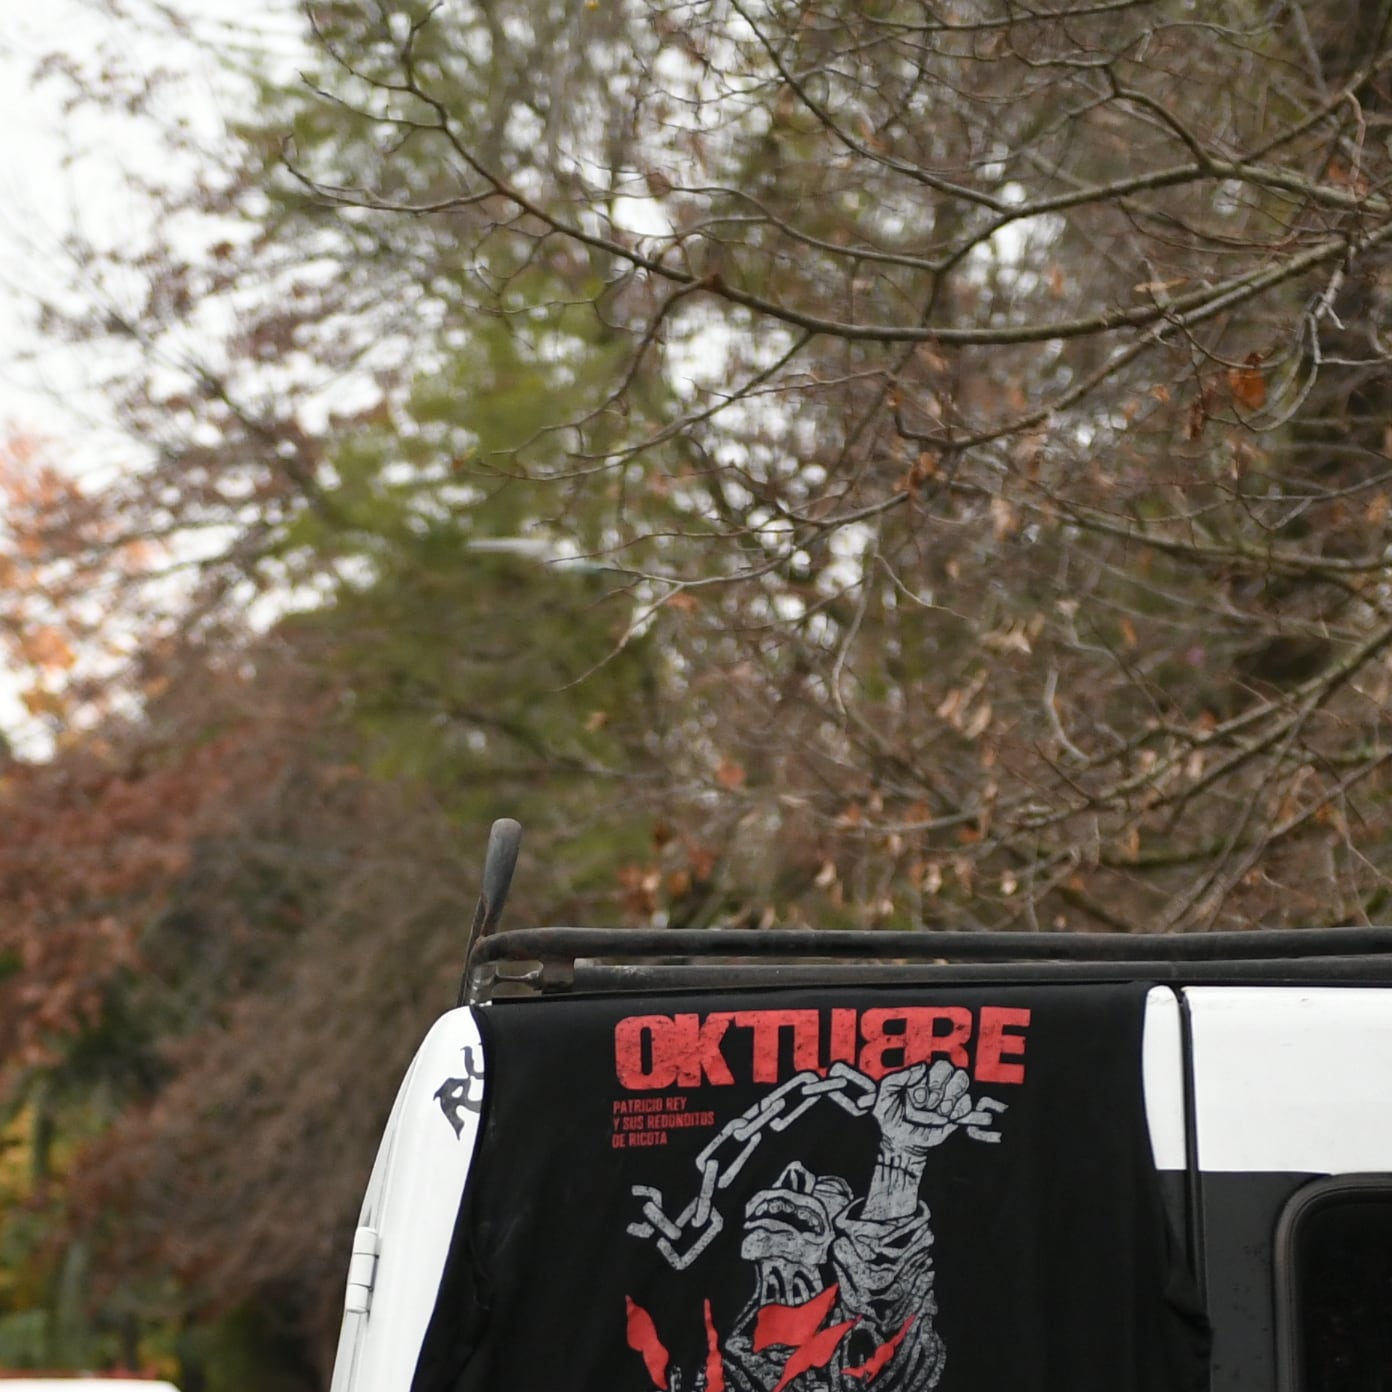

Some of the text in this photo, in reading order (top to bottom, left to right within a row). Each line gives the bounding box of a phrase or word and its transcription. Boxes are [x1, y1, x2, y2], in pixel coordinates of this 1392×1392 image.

[614, 1005, 1031, 1092] OKTUBRE
[613, 1096, 687, 1114] PATRICIO REY
[613, 1111, 715, 1131] Y SUS REDONDITOS
[612, 1131, 668, 1149] DE RICOTA
